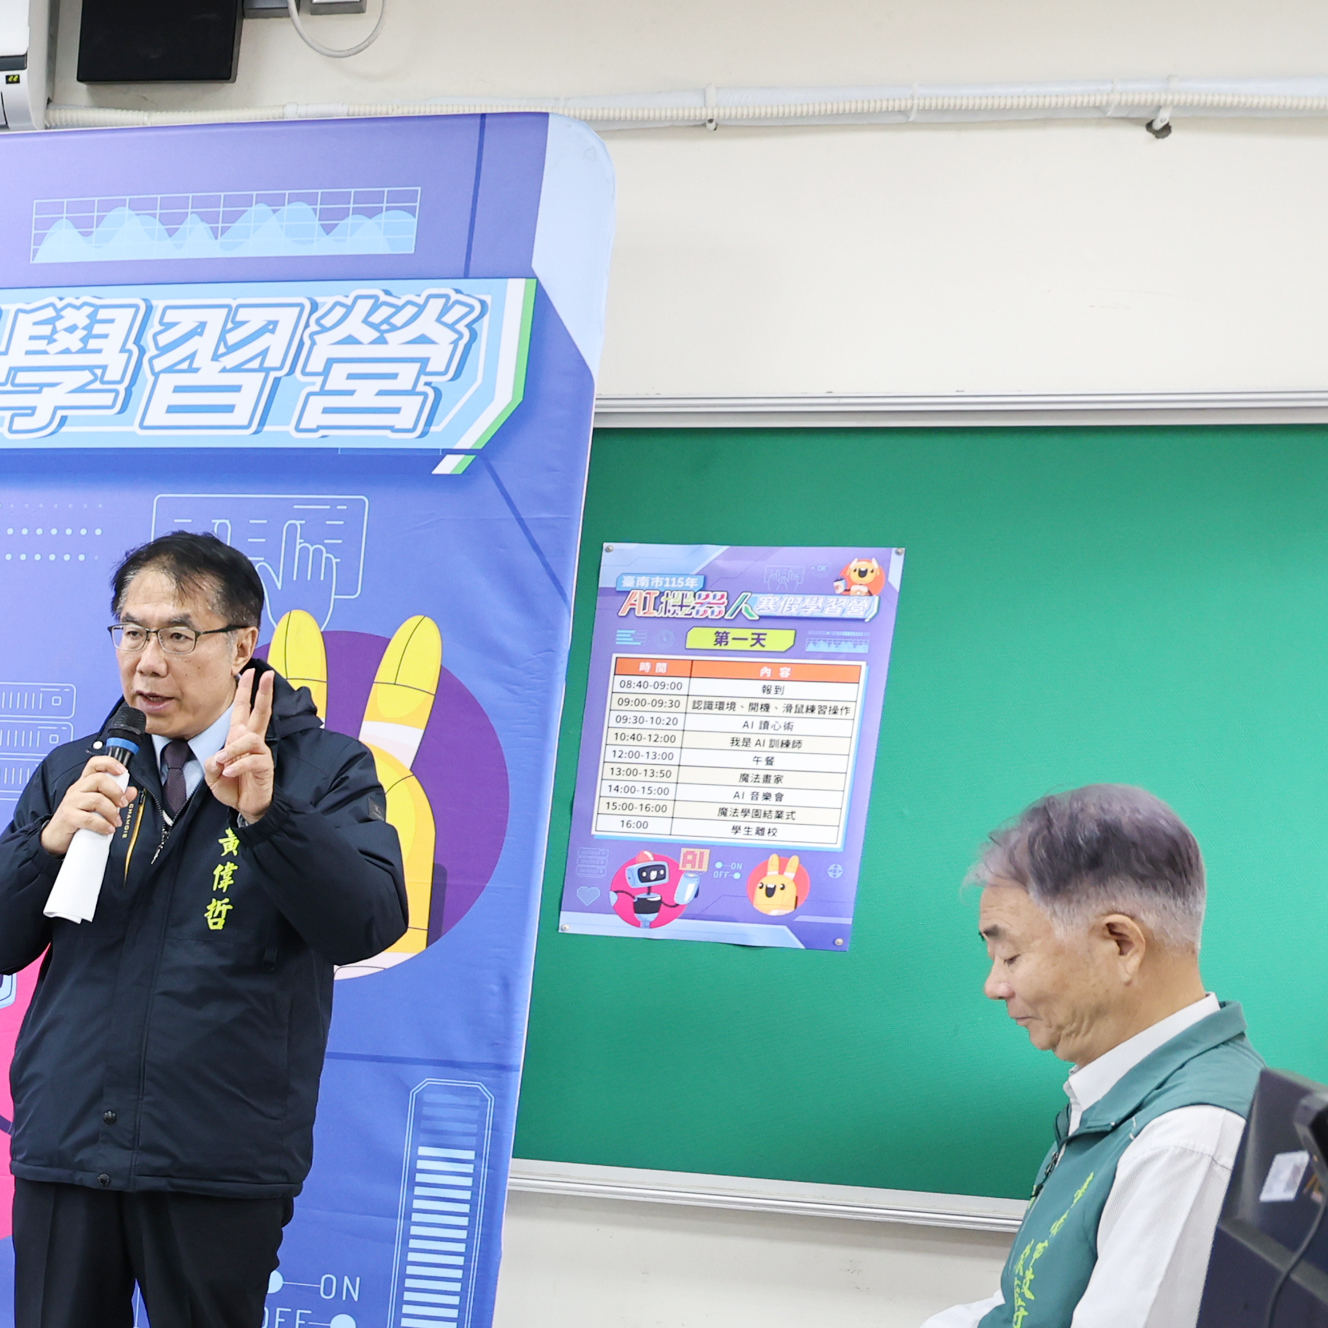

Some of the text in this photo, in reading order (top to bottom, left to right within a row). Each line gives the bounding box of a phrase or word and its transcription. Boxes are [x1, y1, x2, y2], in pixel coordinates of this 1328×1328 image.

[713, 630, 768, 648] 第一天
[619, 679, 683, 691] 08:40-09:00
[761, 684, 785, 696] 報到
[617, 697, 681, 709] 09:00-09:30
[615, 715, 679, 726] 09:30-10:20
[742, 720, 755, 730] AI
[613, 732, 677, 744] 10:40-12:00
[729, 736, 754, 748] 我是
[754, 738, 767, 748] AI
[611, 749, 675, 761] 12:00-13:00
[752, 755, 775, 767] 午餐
[609, 767, 672, 779] 13:00-13:50
[607, 784, 670, 796] 14:00-15:00
[733, 790, 785, 803] AI 音樂會
[605, 801, 668, 813] 15:00-16:00
[620, 819, 649, 830] 16:00
[731, 825, 778, 837] 學生離校
[730, 862, 743, 870] ON
[204, 827, 240, 930] 黃偉哲
[713, 871, 730, 879] OFF
[319, 1273, 360, 1302] ON
